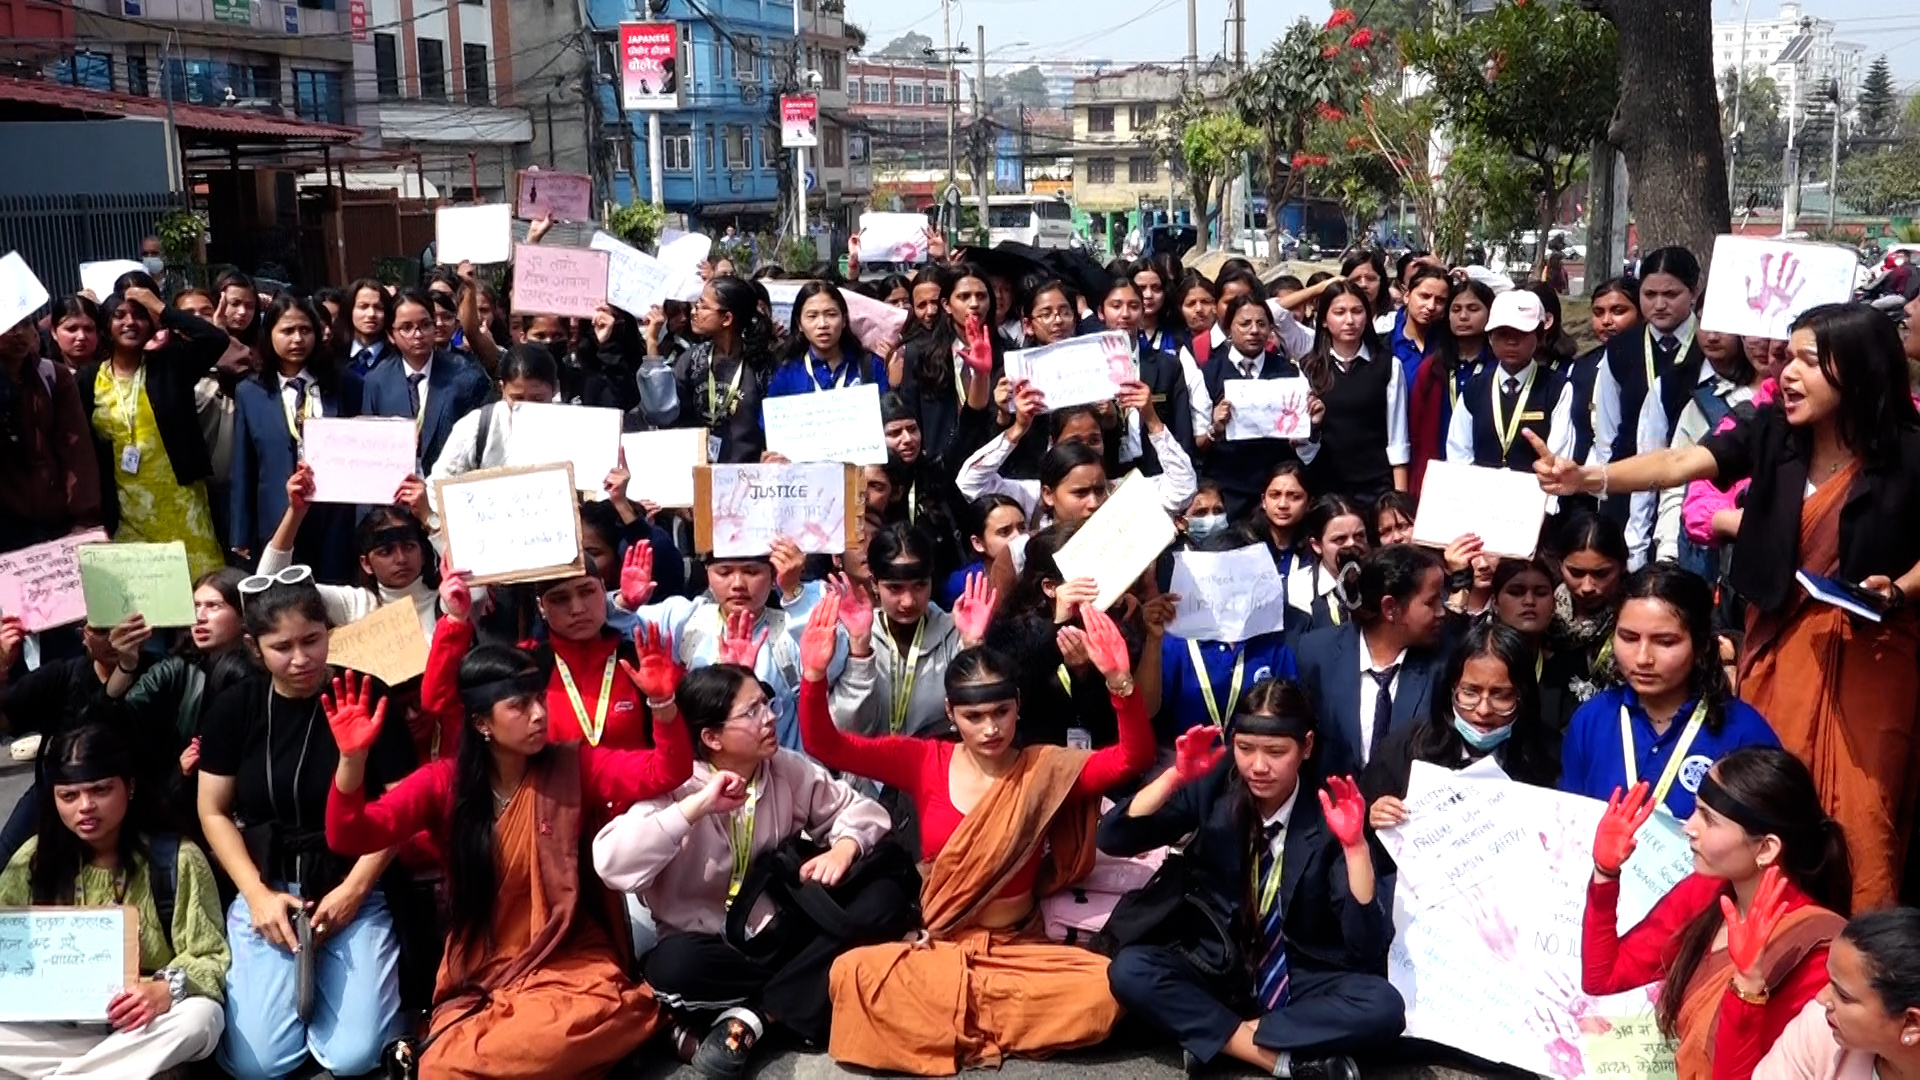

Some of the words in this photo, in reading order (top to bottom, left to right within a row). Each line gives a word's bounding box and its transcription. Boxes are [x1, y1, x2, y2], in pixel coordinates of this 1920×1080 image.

[627, 33, 670, 43] JAPANESE
[750, 485, 807, 498] JUSTICE
[1534, 930, 1560, 956] NO
